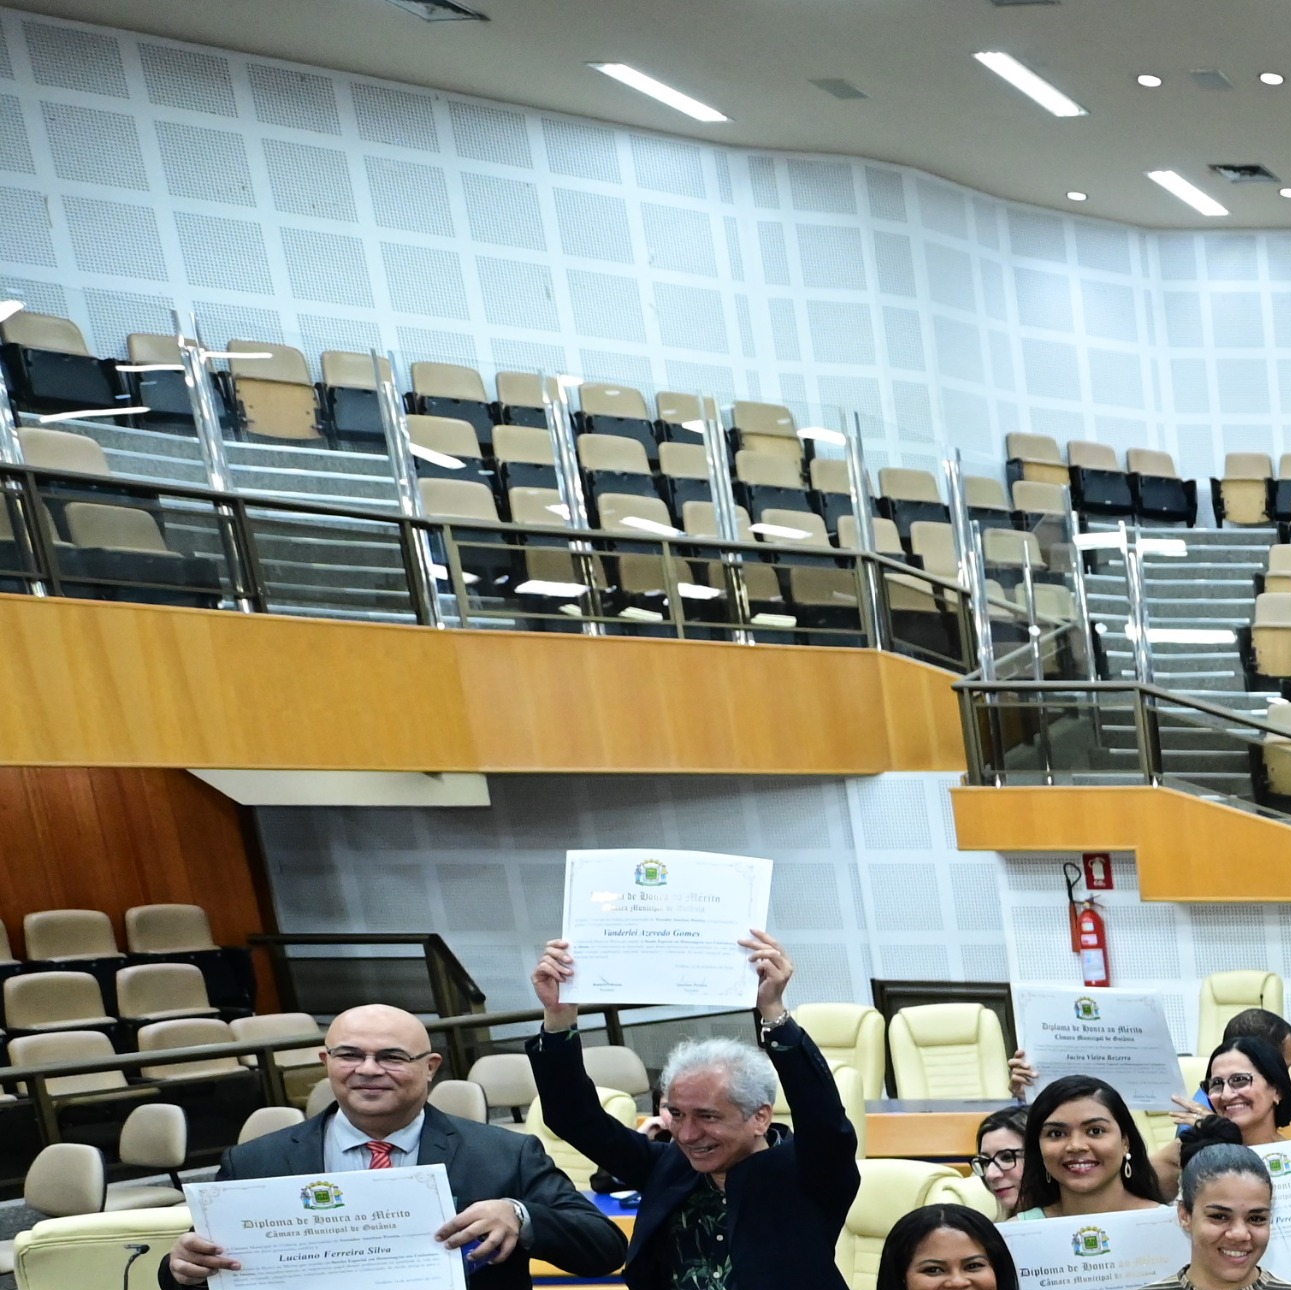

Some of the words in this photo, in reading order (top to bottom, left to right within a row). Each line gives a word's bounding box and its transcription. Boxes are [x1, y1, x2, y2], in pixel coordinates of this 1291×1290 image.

[604, 928, 638, 937] Vanderlei
[639, 929, 671, 937] Azevedo
[672, 929, 700, 937] Gomes
[240, 1219, 293, 1230] Diploma
[295, 1217, 309, 1226] de
[312, 1215, 351, 1226] Honra
[354, 1214, 367, 1222] ao
[371, 1209, 411, 1223] Mérito
[265, 1230, 301, 1239] Câmara
[303, 1225, 348, 1237] Municipal
[362, 1222, 397, 1231] Goiânia
[279, 1253, 320, 1262] Luciano
[324, 1248, 365, 1259] Ferreira
[367, 1246, 391, 1255] Silva
[1019, 1266, 1065, 1278] Diploma
[1066, 1264, 1079, 1273] de
[1081, 1261, 1116, 1273] Honra
[1039, 1278, 1071, 1287] Câmara
[1073, 1272, 1113, 1284] Municipal
